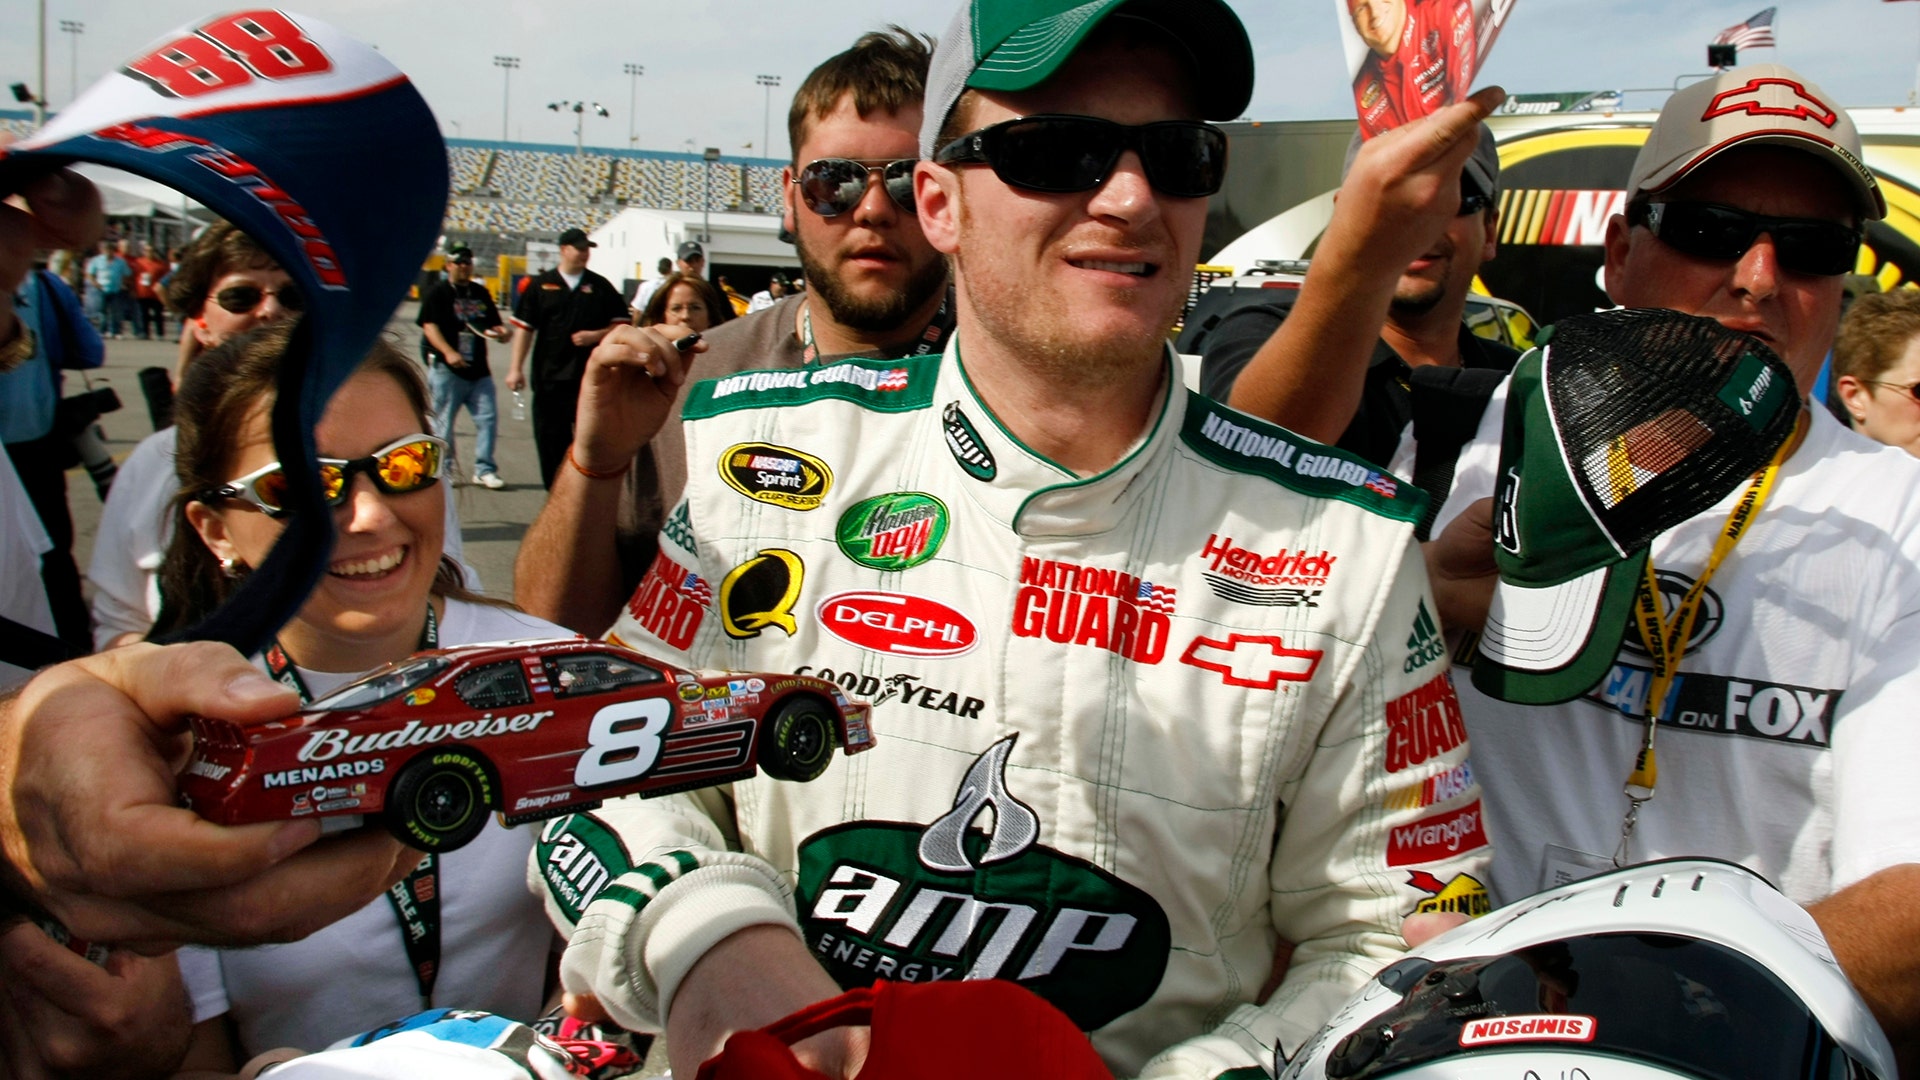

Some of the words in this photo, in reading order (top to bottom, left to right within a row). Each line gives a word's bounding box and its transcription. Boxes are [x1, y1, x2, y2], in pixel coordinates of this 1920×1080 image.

[120, 8, 336, 99] 88
[712, 371, 809, 399] NATIONAL
[810, 364, 879, 391] GUARD
[750, 455, 799, 473] NASCAR
[1200, 411, 1297, 468] NATIONAL
[1295, 453, 1370, 487] GUARD
[755, 471, 802, 488] Sprint
[1200, 533, 1338, 577] Hendrick
[1221, 565, 1329, 586] MOTORSPORTS
[1020, 557, 1141, 602] NATIONAL
[834, 604, 963, 645] DELPHI
[1012, 585, 1171, 665] GUARD
[1678, 710, 1718, 729] ON
[1725, 680, 1830, 743] FOX
[297, 710, 555, 763] Budweiser
[574, 697, 672, 788] 8
[1385, 697, 1468, 774] GUAR
[264, 758, 385, 788] MENARDS
[432, 754, 491, 805] GOODYEAR
[514, 791, 571, 811] Snap-on
[406, 820, 440, 846] EAGLE
[1395, 811, 1478, 851] Wrangler
[547, 863, 580, 906] ENERGY
[549, 832, 615, 911] am
[811, 865, 1138, 983] amp
[818, 933, 954, 983] ENERGY
[1471, 1018, 1584, 1039] SIMPSON
